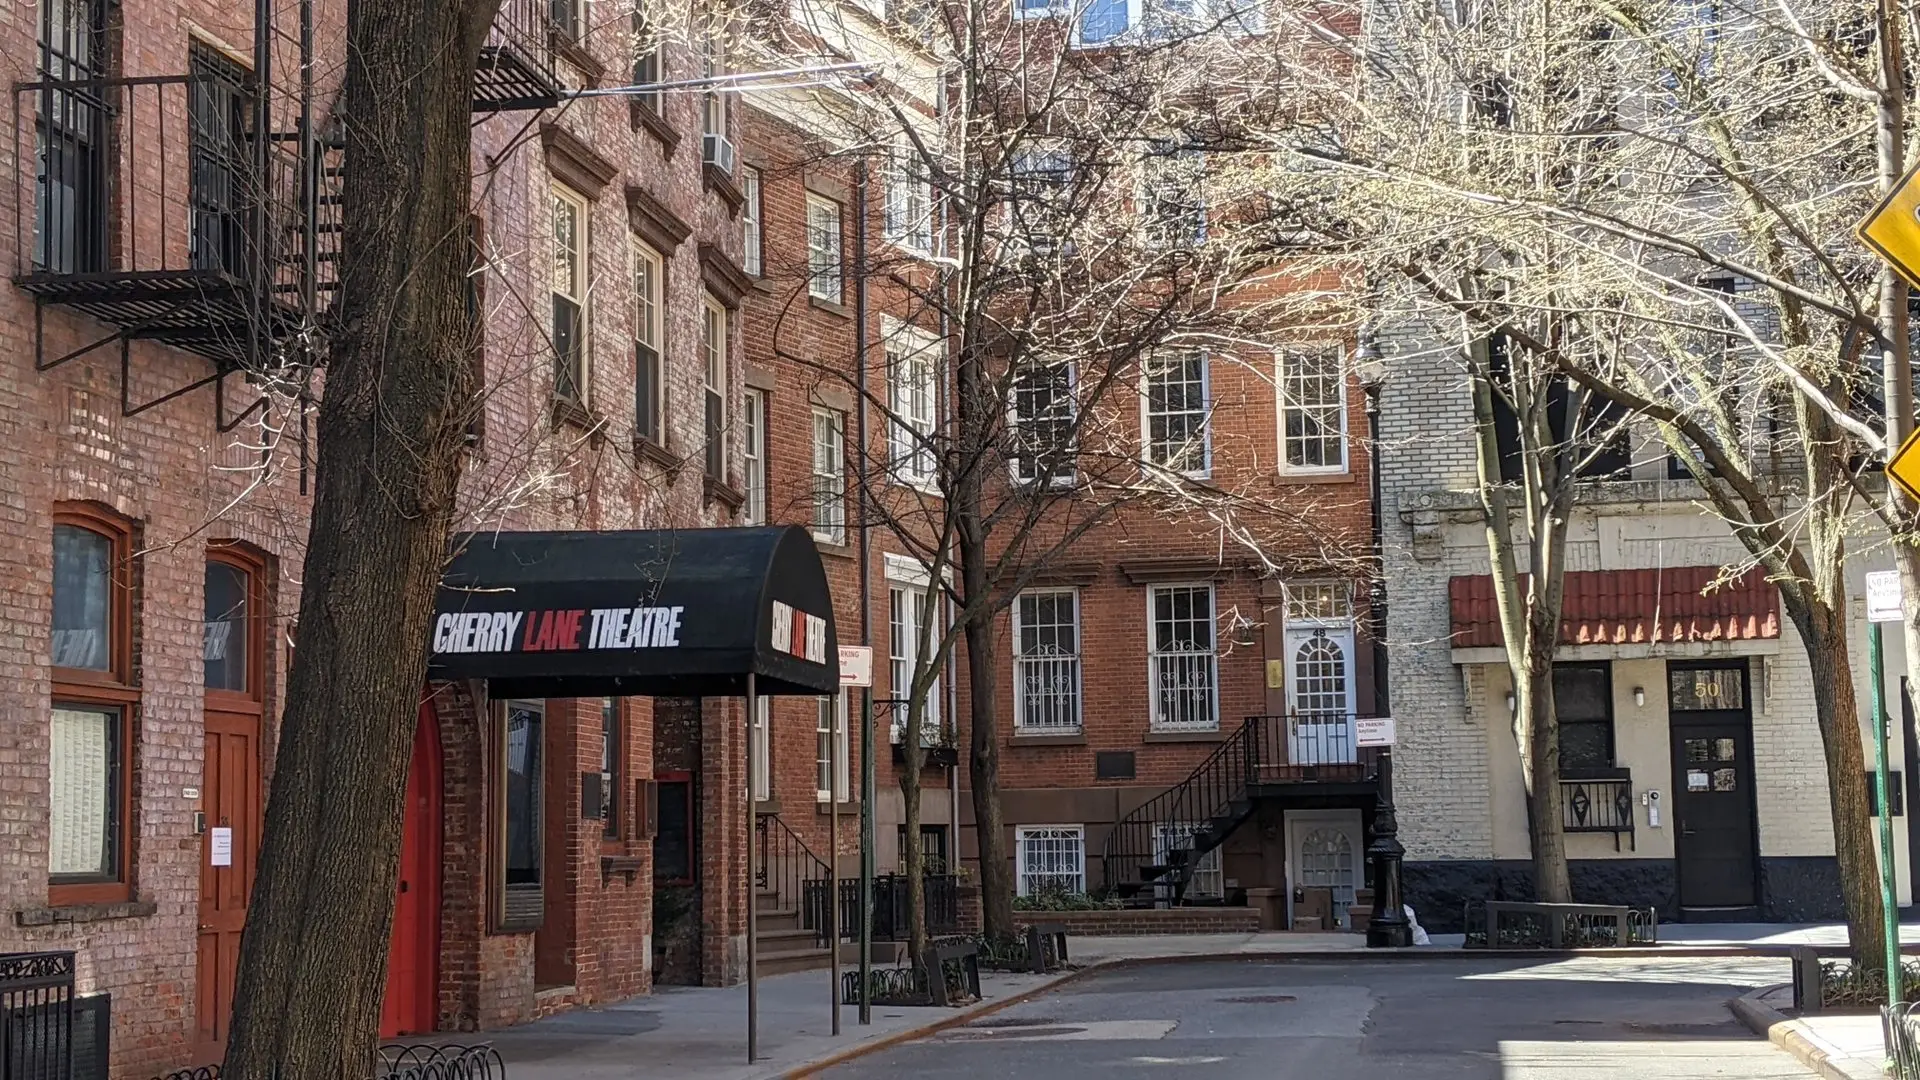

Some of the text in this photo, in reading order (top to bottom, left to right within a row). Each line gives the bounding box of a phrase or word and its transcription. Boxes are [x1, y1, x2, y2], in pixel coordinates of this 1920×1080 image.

[432, 606, 685, 654] CHERRY LANE THEATRE
[1313, 629, 1326, 637] 48
[840, 650, 860, 658] RKING
[1695, 682, 1719, 698] 50
